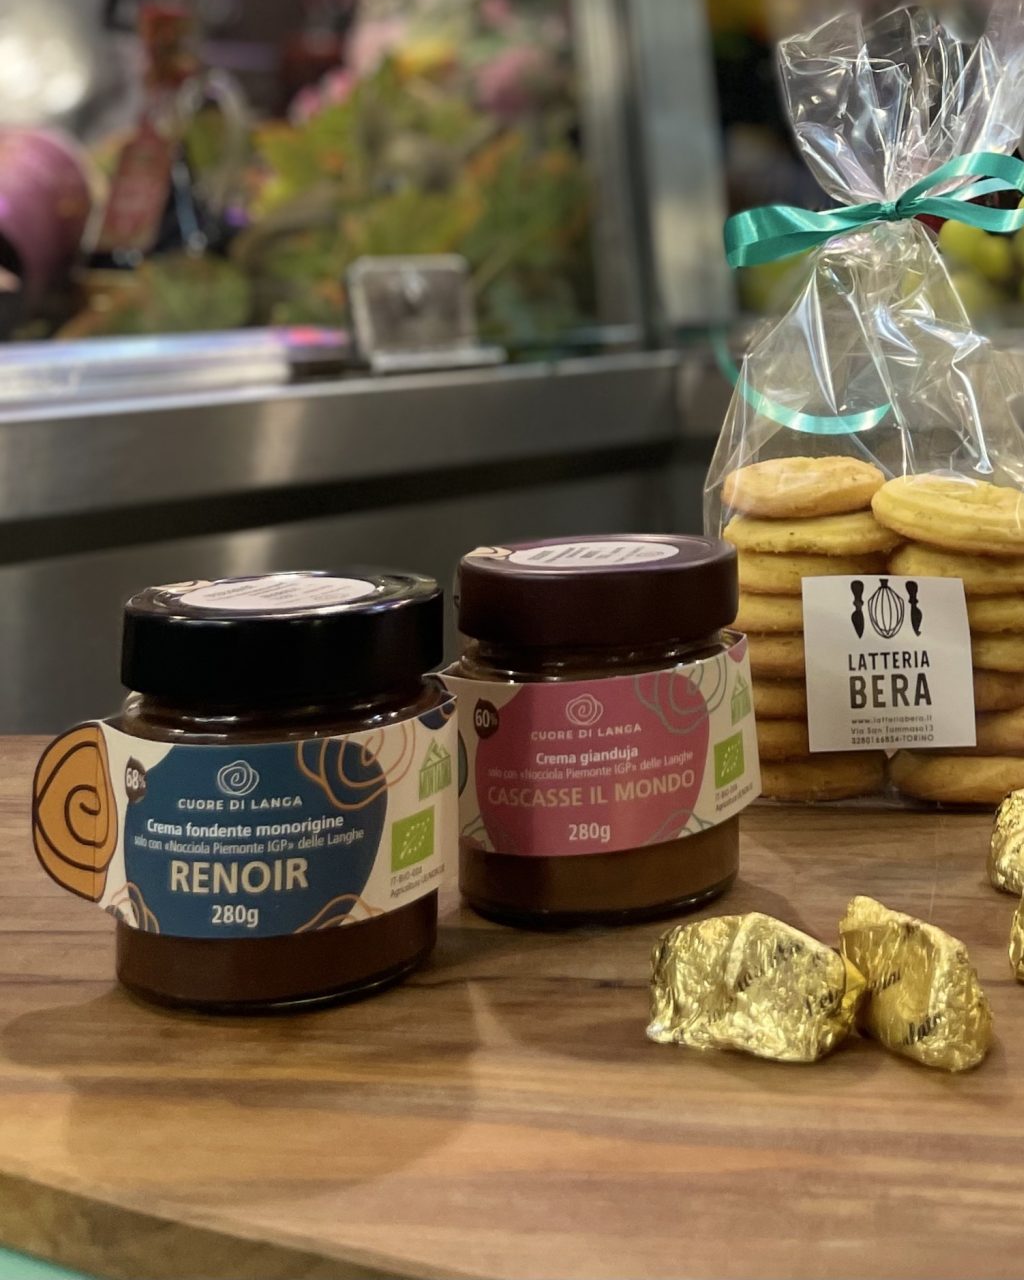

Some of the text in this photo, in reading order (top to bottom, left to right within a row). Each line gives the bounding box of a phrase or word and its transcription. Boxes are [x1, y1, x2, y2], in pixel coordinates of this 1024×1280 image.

[848, 650, 930, 671] LATTERIA
[849, 672, 932, 709] BERA
[531, 723, 642, 740] CUORE DI LANGA
[851, 727, 864, 735] Via
[536, 745, 639, 766] Crema gianduja
[566, 765, 612, 780] Piemonte
[640, 757, 661, 771] delle
[664, 751, 693, 767] Langhe
[488, 770, 695, 808] CASCASSE IL MONDO
[178, 796, 303, 810] CUORE DI LANGA
[147, 814, 344, 838] Crema fondente monorigine
[568, 823, 611, 842] 280g
[148, 838, 162, 849] con
[213, 841, 264, 855] Piemonte
[298, 834, 323, 849] delle
[327, 827, 364, 846] Langhe
[171, 857, 309, 894] RENOIR
[211, 905, 259, 928] 280g
